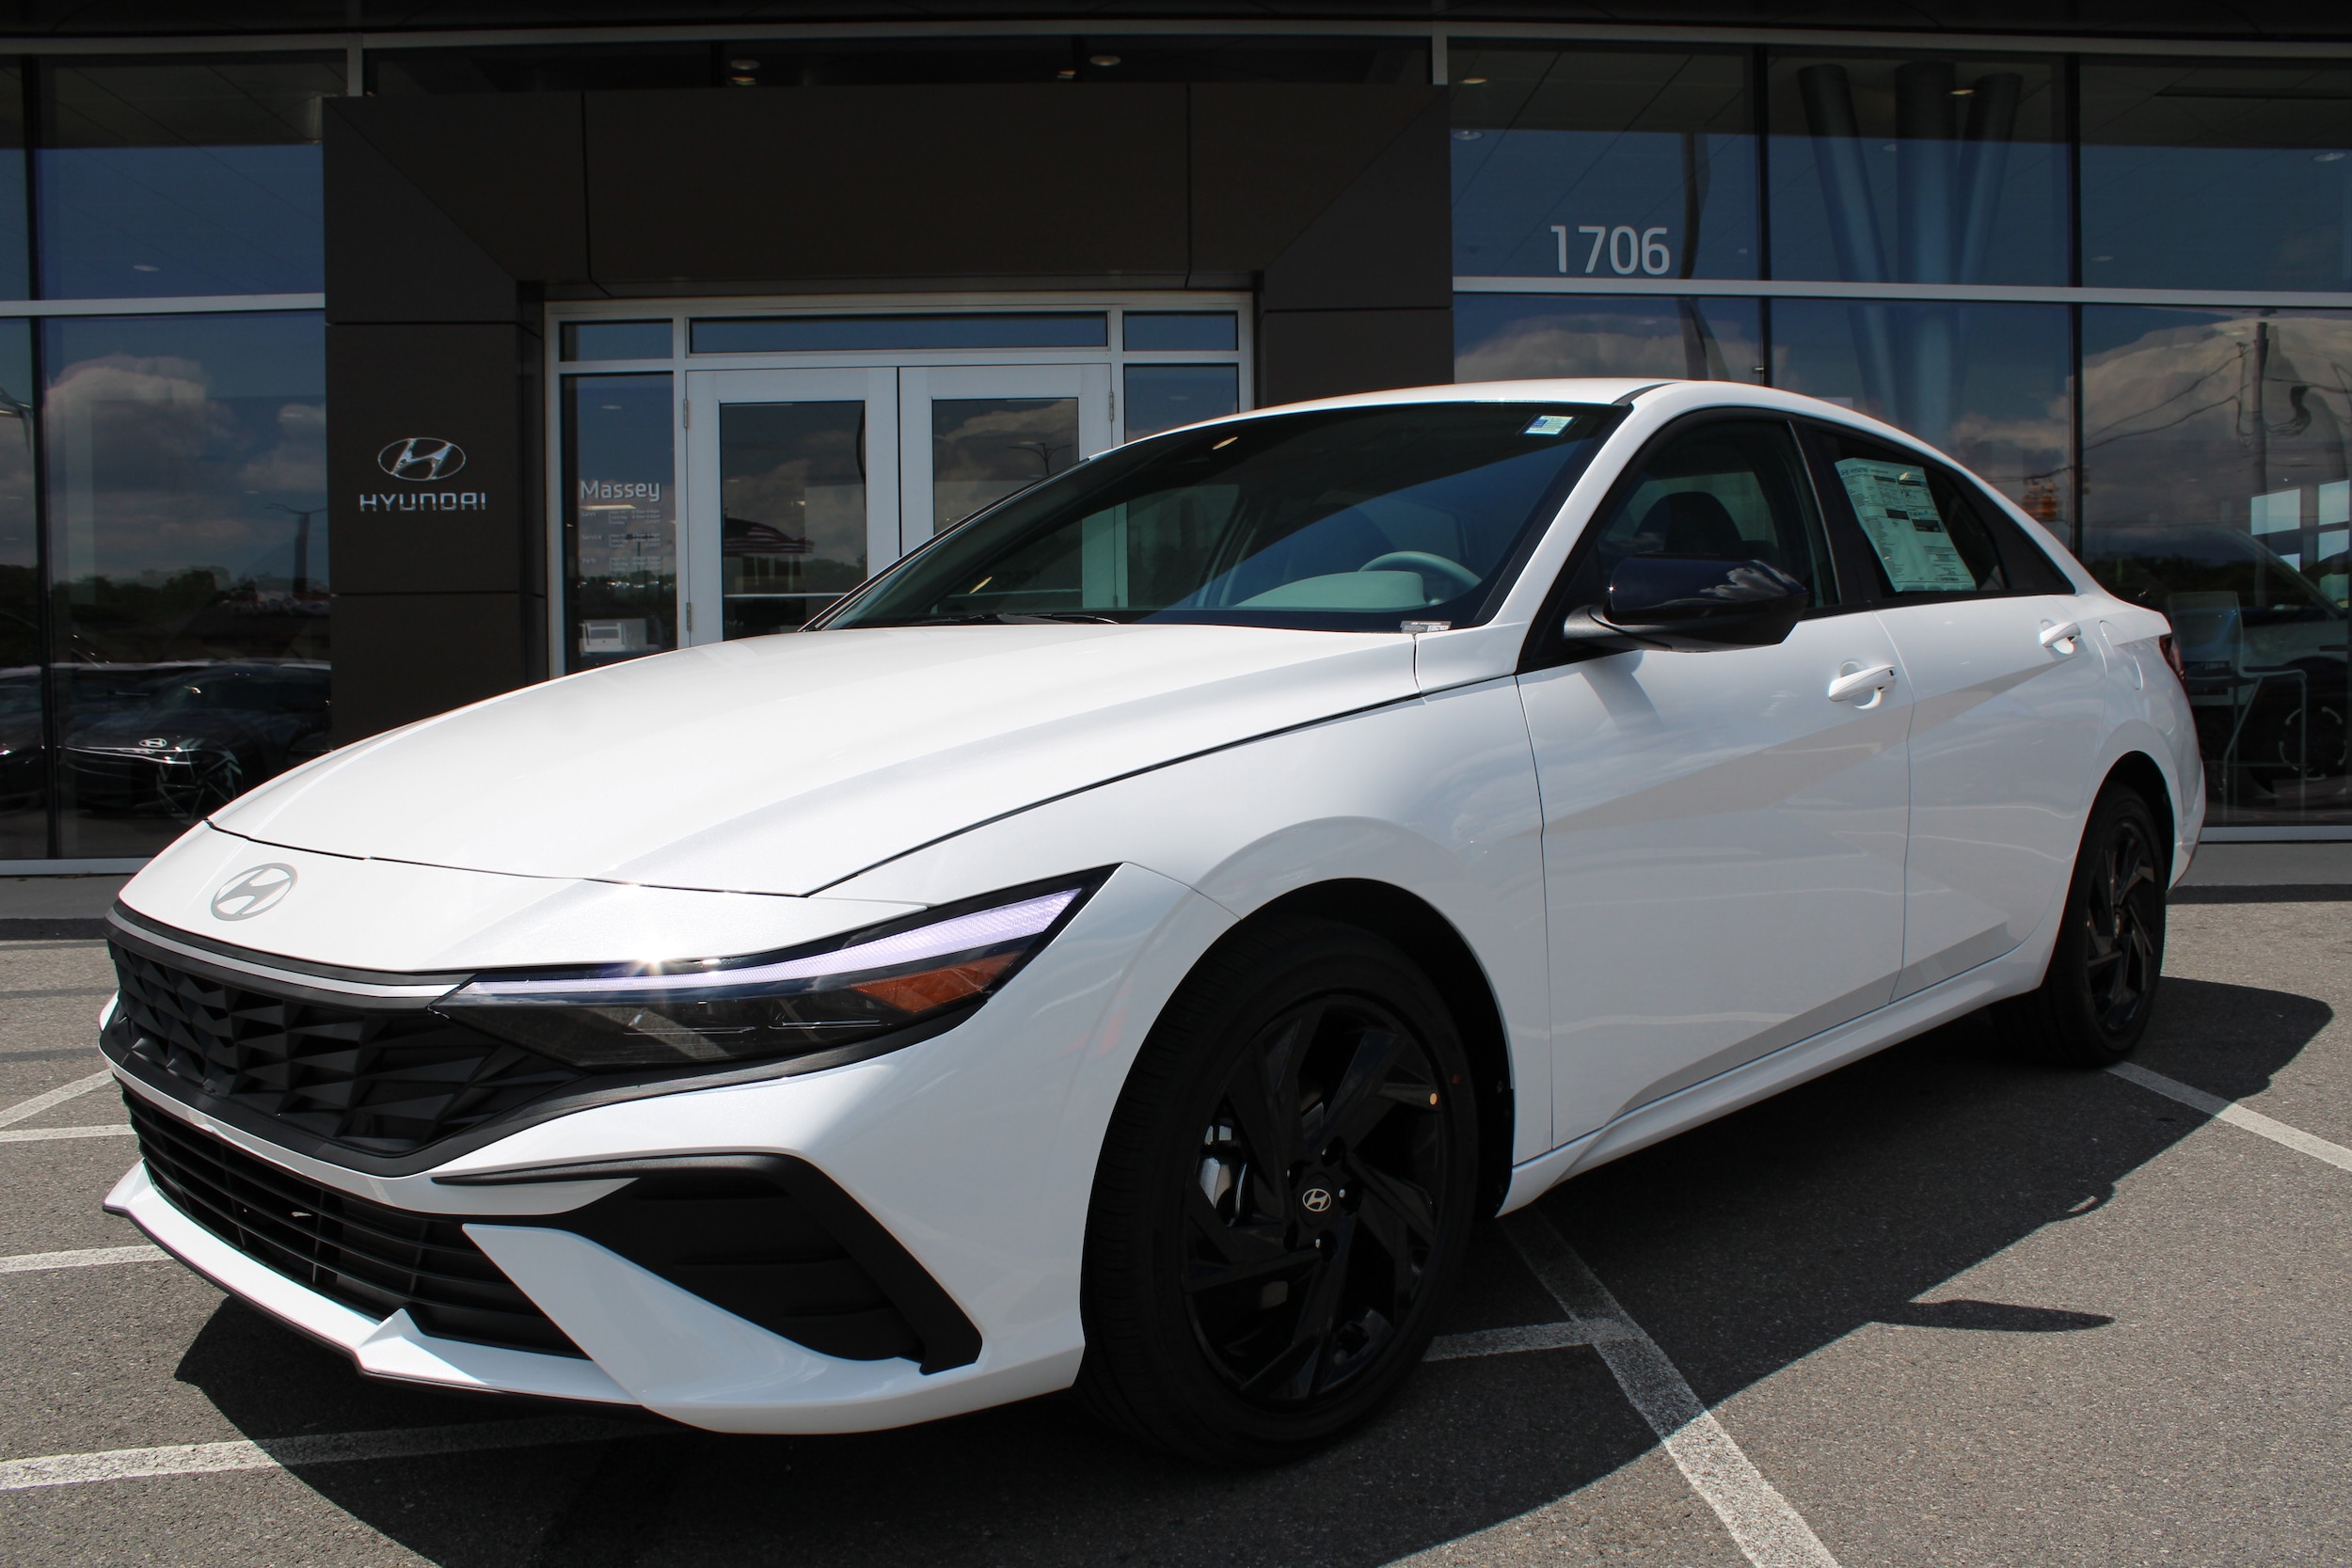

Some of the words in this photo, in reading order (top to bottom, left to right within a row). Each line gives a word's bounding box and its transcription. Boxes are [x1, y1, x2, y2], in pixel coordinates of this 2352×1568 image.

[1550, 226, 1670, 275] 1706
[580, 480, 660, 501] Massey
[359, 492, 486, 512] HYUNDAI
